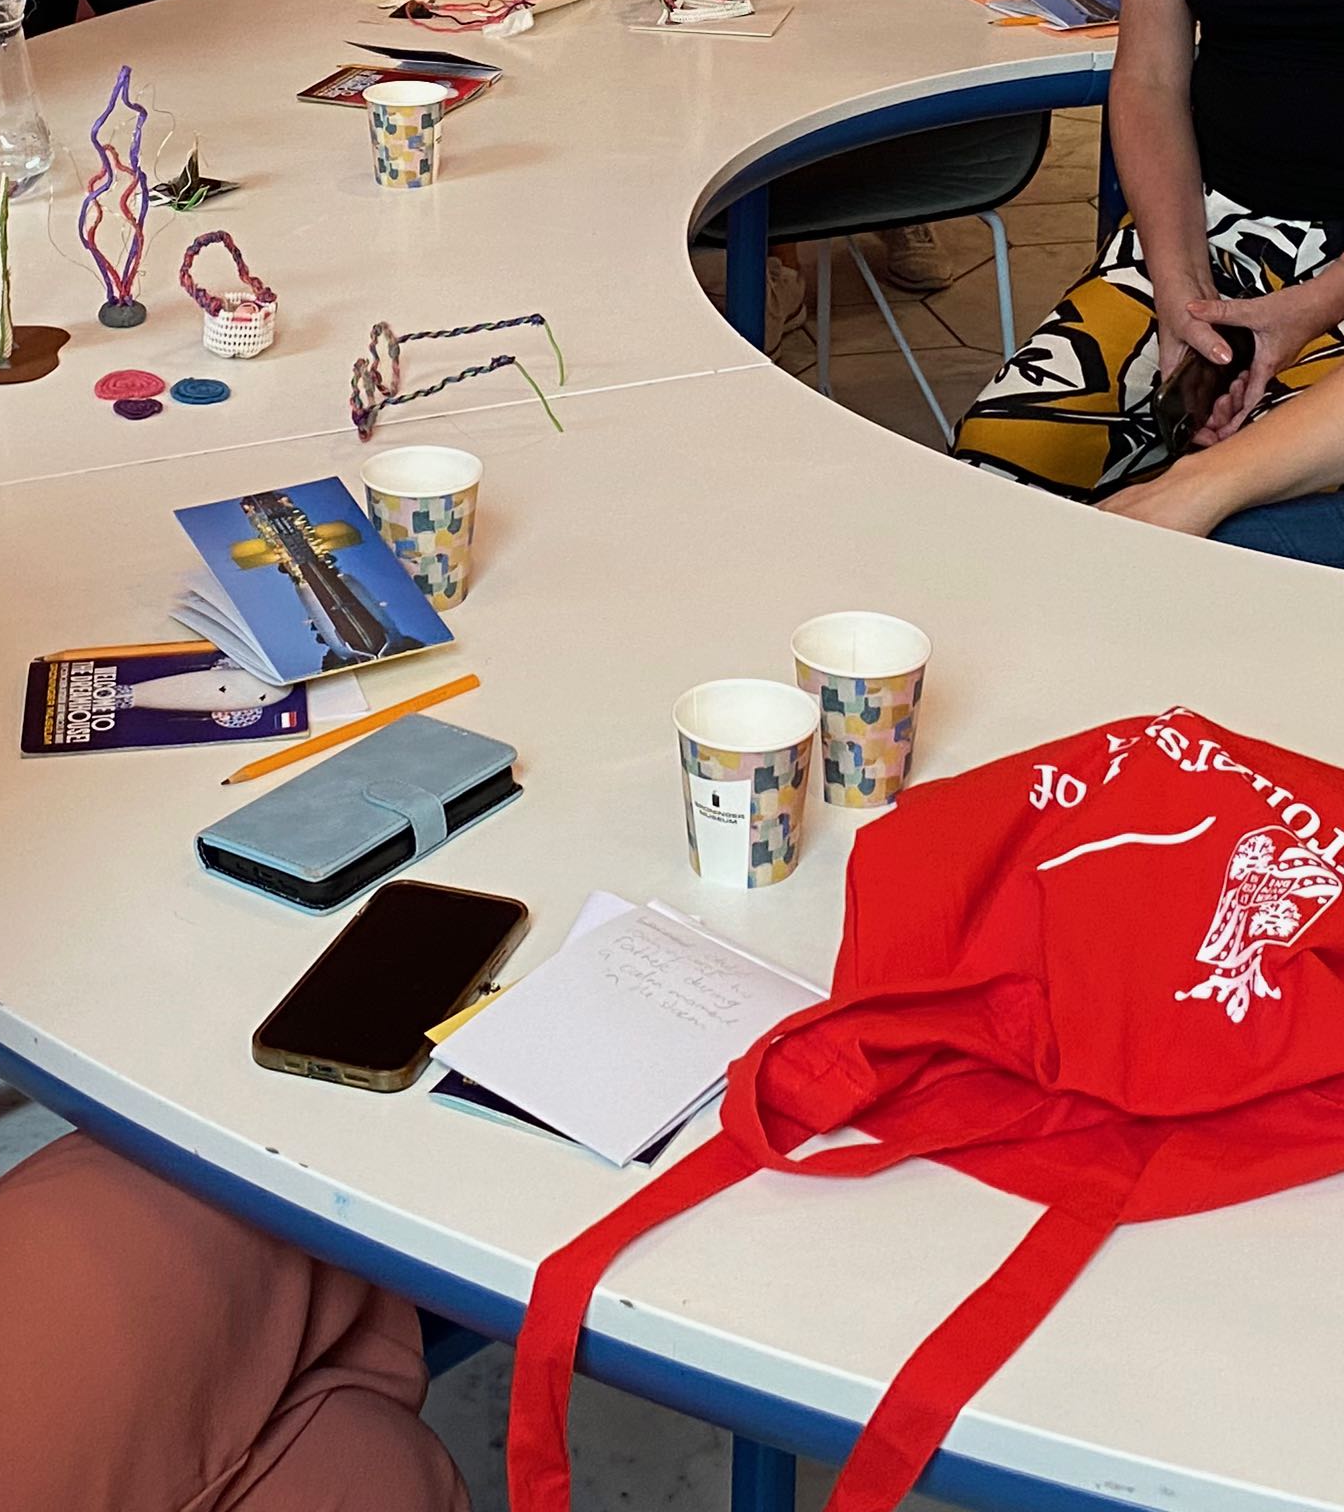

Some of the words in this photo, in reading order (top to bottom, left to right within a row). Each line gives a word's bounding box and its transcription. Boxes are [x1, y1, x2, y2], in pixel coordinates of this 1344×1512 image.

[71, 661, 94, 675] THE
[93, 666, 117, 713] WELCOME
[66, 675, 93, 743] DREAMHOUSE!
[91, 713, 115, 731] TO
[699, 810, 738, 824] MUSEUM
